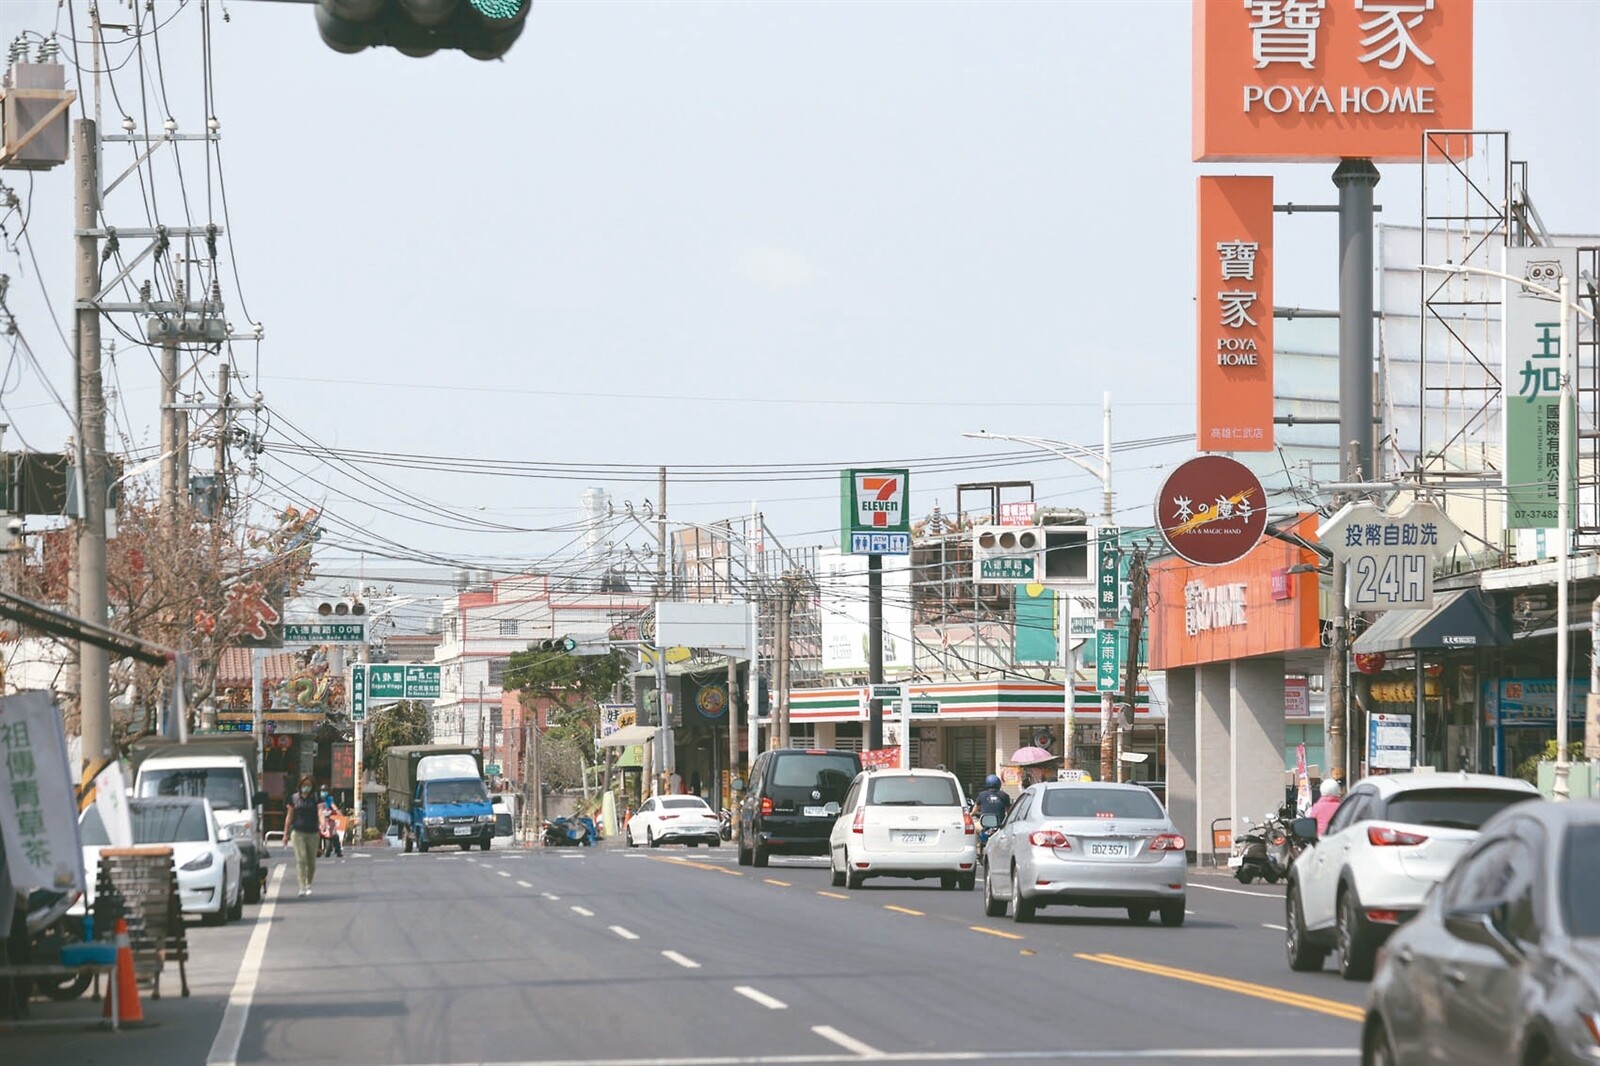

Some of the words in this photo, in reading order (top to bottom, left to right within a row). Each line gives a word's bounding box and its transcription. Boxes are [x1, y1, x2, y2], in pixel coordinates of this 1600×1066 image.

[1243, 0, 1436, 70] 寶家
[1243, 85, 1335, 114] POYA
[1340, 86, 1435, 114] HOME
[1216, 239, 1259, 329] 寶家
[1217, 338, 1257, 351] POYA
[1217, 353, 1258, 366] HOME
[1210, 427, 1264, 439] 高雄仁武店
[863, 477, 897, 528] 7
[1172, 494, 1253, 525] 茶の魔手
[1345, 523, 1438, 547] 投幣自助洗
[1356, 555, 1426, 603] 24H
[1102, 632, 1115, 674] 法雨寺
